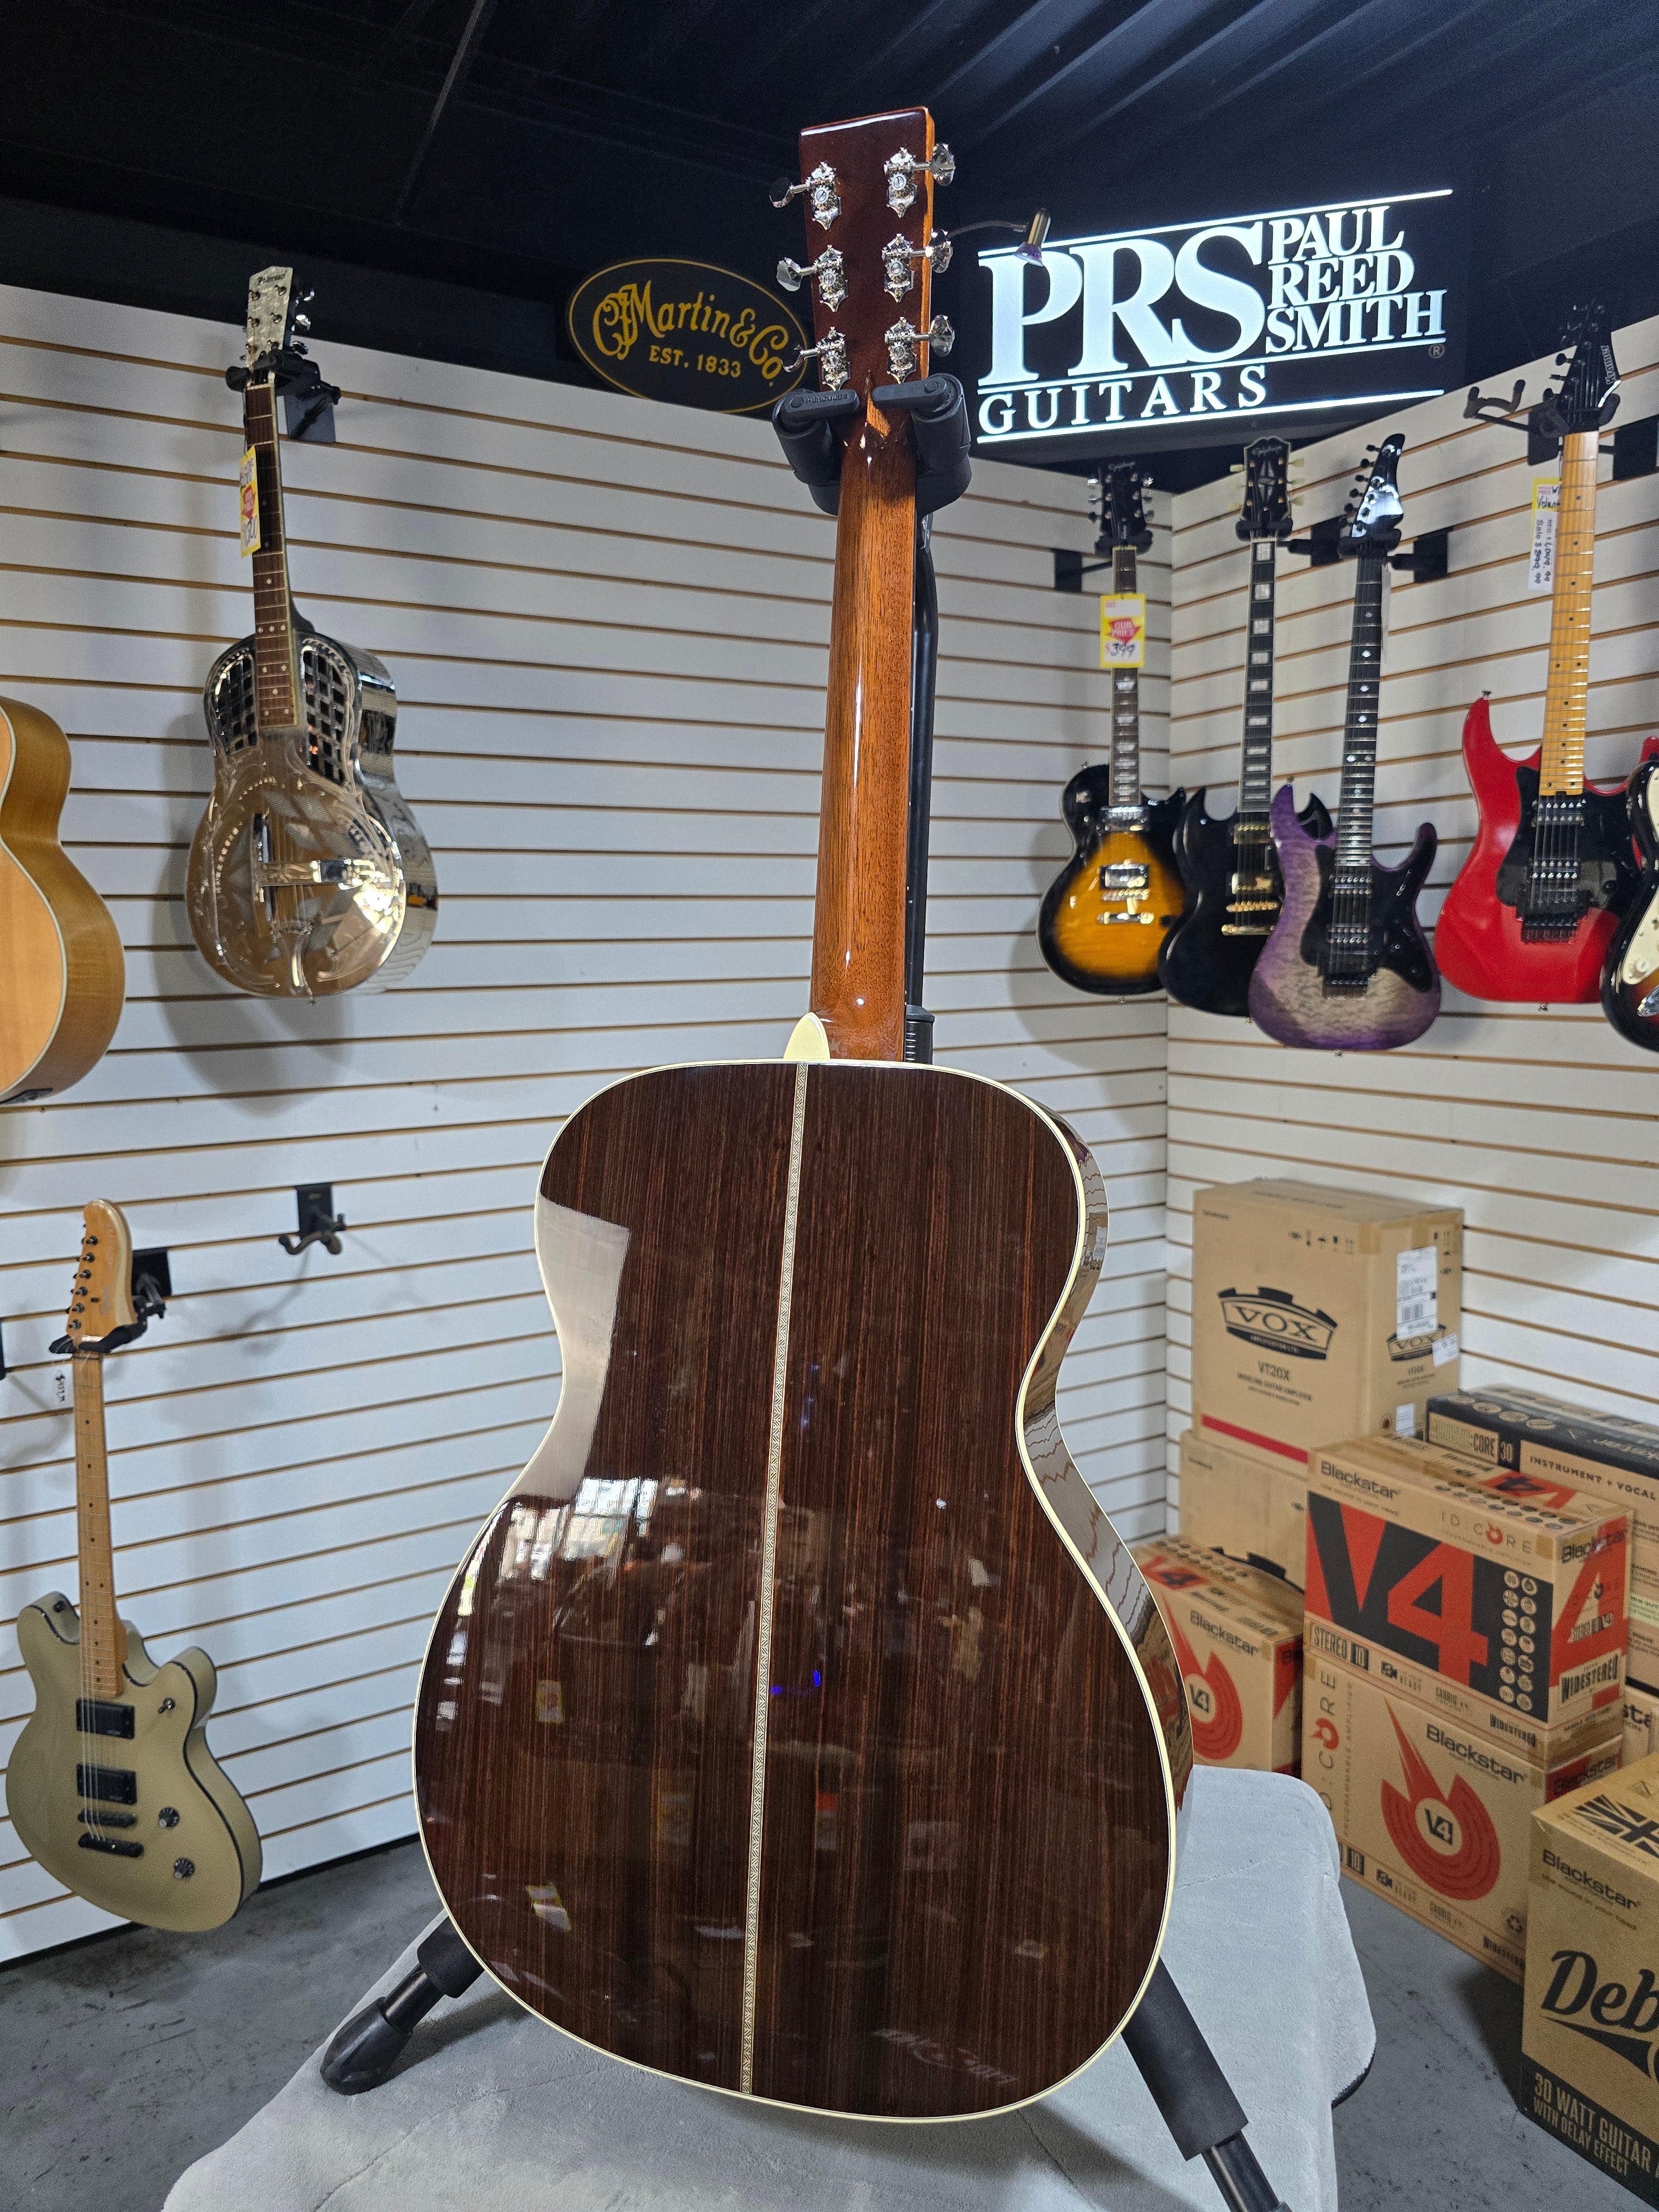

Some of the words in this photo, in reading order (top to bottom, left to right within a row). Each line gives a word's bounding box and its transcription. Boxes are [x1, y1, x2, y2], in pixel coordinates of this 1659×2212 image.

[1269, 206, 1405, 266] PAUL
[1267, 249, 1416, 310] REED
[978, 221, 1266, 387] PRS
[1264, 289, 1447, 355] SMITH
[648, 345, 688, 368] EST.
[696, 353, 742, 378] 1833
[806, 393, 848, 404] HERCULES
[978, 365, 1267, 435] GUITARS
[1232, 1303, 1318, 1343] VOX
[1258, 1360, 1291, 1381] VT20X
[1500, 1441, 1515, 1463] 30
[1320, 1460, 1399, 1500] Blackstar
[1529, 1455, 1602, 1484] INSTRUMENT
[1616, 1481, 1656, 1501] VOCAL
[1562, 1530, 1625, 1564] Blacktar
[1190, 1609, 1259, 1656] Blackstar
[1314, 1626, 1348, 1660] STEREO
[1561, 1654, 1619, 1704] WIDESTEREO
[1426, 1723, 1524, 1786] Blackstar
[1542, 1848, 1639, 1910] Blackstar
[1533, 2097, 1558, 2128] WITH
[1561, 2117, 1591, 2151] DELAY
[1593, 2138, 1629, 2178] EFFECT
[1535, 2072, 1552, 2103] 30
[1557, 2085, 1596, 2127] WATT
[1599, 2117, 1652, 2173] GUITAR
